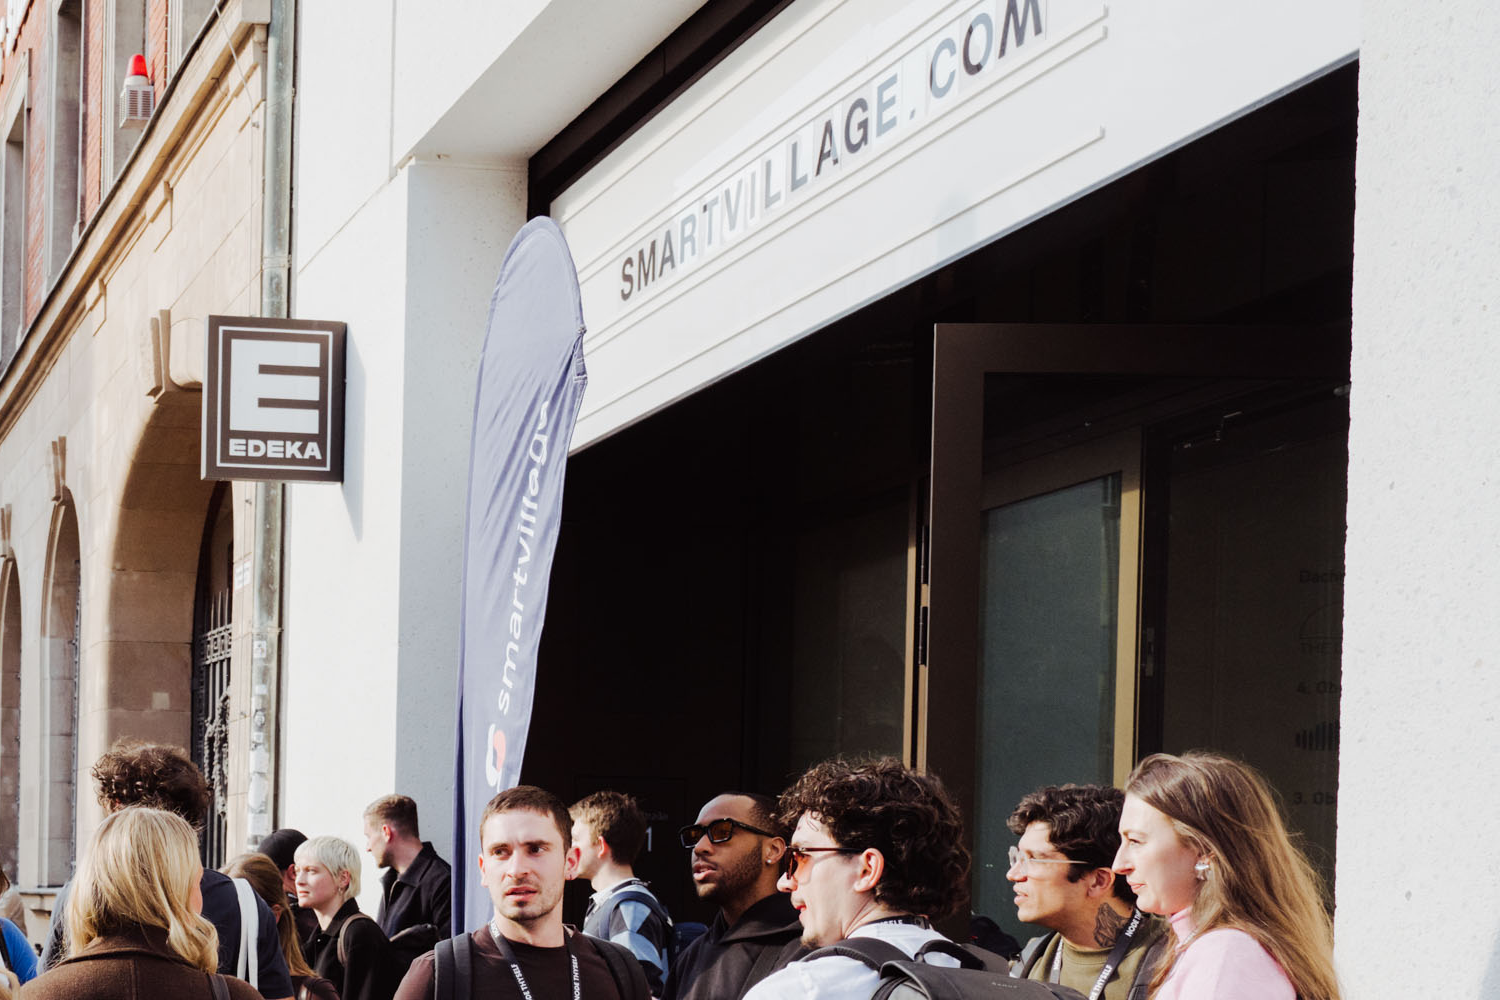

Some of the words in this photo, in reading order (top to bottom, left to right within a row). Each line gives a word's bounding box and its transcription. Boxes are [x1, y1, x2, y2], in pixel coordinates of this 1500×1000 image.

[620, 0, 1043, 301] SMARTVILLAGE.COM
[229, 437, 322, 460] EDEKA
[1125, 917, 1140, 937] NODE
[510, 963, 528, 992] THYSELF
[571, 954, 580, 982] THYSELF
[1095, 964, 1114, 993] THYSELF
